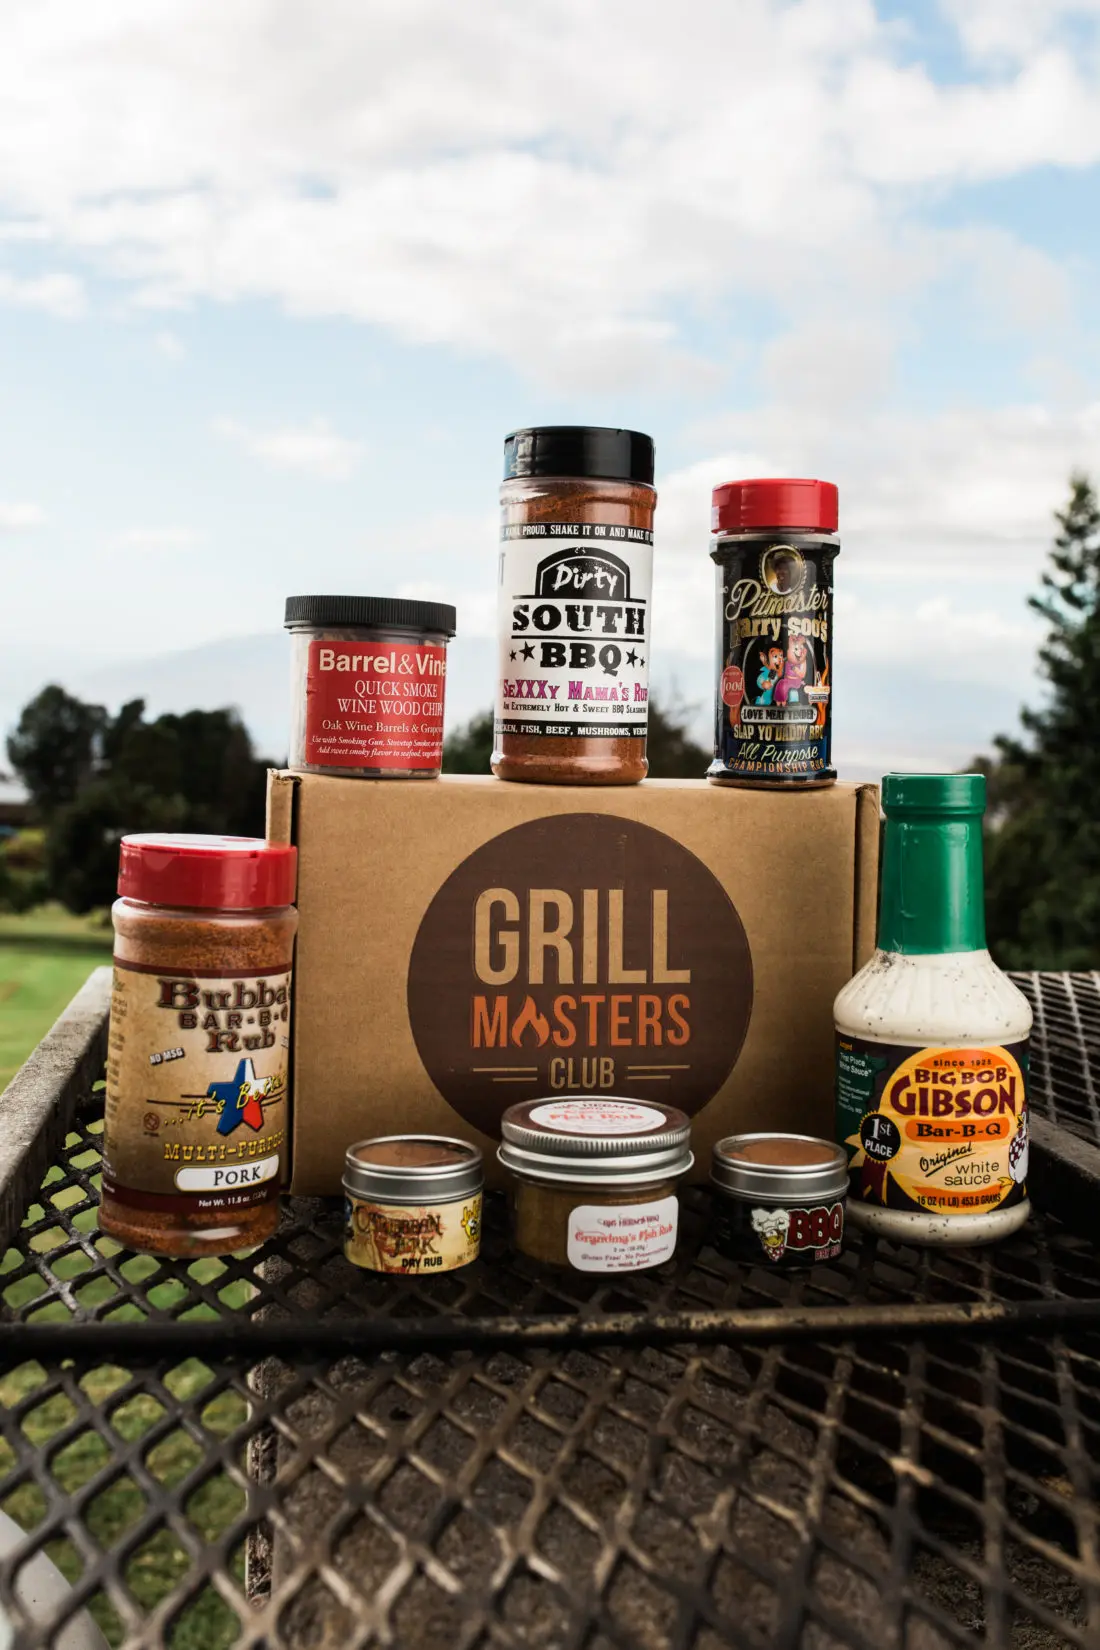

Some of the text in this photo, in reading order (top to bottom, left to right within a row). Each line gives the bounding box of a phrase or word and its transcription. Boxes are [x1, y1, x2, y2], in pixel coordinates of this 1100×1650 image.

[522, 525, 547, 536] PROUD,
[550, 524, 579, 535] SHAKE
[582, 525, 591, 536] IT
[594, 526, 606, 536] ON
[609, 526, 626, 538] AND
[627, 529, 644, 540] MAKE
[552, 563, 618, 599] Dirty
[725, 578, 829, 621] Pitmaster
[512, 604, 646, 635] SOUTH
[319, 649, 447, 676] Barrel & Vine
[539, 642, 622, 677] BBQ
[354, 680, 438, 698] QUICK SMOKE
[337, 698, 377, 714] WINE
[380, 700, 421, 716] WOOD
[573, 703, 579, 712] &
[612, 704, 625, 714] BBQ
[743, 709, 764, 720] LOVE
[765, 709, 786, 720] MEAT
[321, 719, 342, 731] Oak
[344, 720, 373, 732] Wine
[375, 721, 410, 733] Barrels
[411, 723, 419, 733] &
[520, 725, 542, 735] FISH,
[545, 725, 574, 736] BEEF,
[577, 727, 631, 737] MUSHROOMS,
[733, 724, 755, 739] SLAP
[774, 724, 808, 742] DADDY
[338, 736, 367, 747] Smoking
[348, 748, 370, 757] smoky
[370, 748, 393, 758] flavor
[737, 742, 818, 765] All Purpose
[728, 757, 808, 773] CHAMPIONSHIP
[473, 887, 691, 985] GRILL
[205, 1029, 276, 1053] Rub
[150, 1047, 184, 1065] NO MSG
[933, 1059, 965, 1067] since
[550, 1057, 615, 1089] CLUB
[914, 1066, 1007, 1087] BIG BOB
[890, 1075, 1016, 1118] GIBSON
[871, 1118, 892, 1140] 1st
[916, 1122, 1002, 1138] Bar-B-Q
[864, 1138, 893, 1158] PLACE
[919, 1141, 974, 1173] Original
[213, 1166, 262, 1186] PORK
[955, 1161, 1000, 1175] white
[944, 1173, 991, 1186] sauce
[198, 1199, 212, 1207] Net
[213, 1198, 225, 1206] Wt.
[227, 1195, 242, 1205] 11.8
[917, 1195, 926, 1205] 16
[927, 1196, 937, 1206] OZ
[961, 1195, 980, 1206] 453.6
[980, 1192, 1001, 1205] GRAMS
[401, 1256, 443, 1268] DRY RUB
